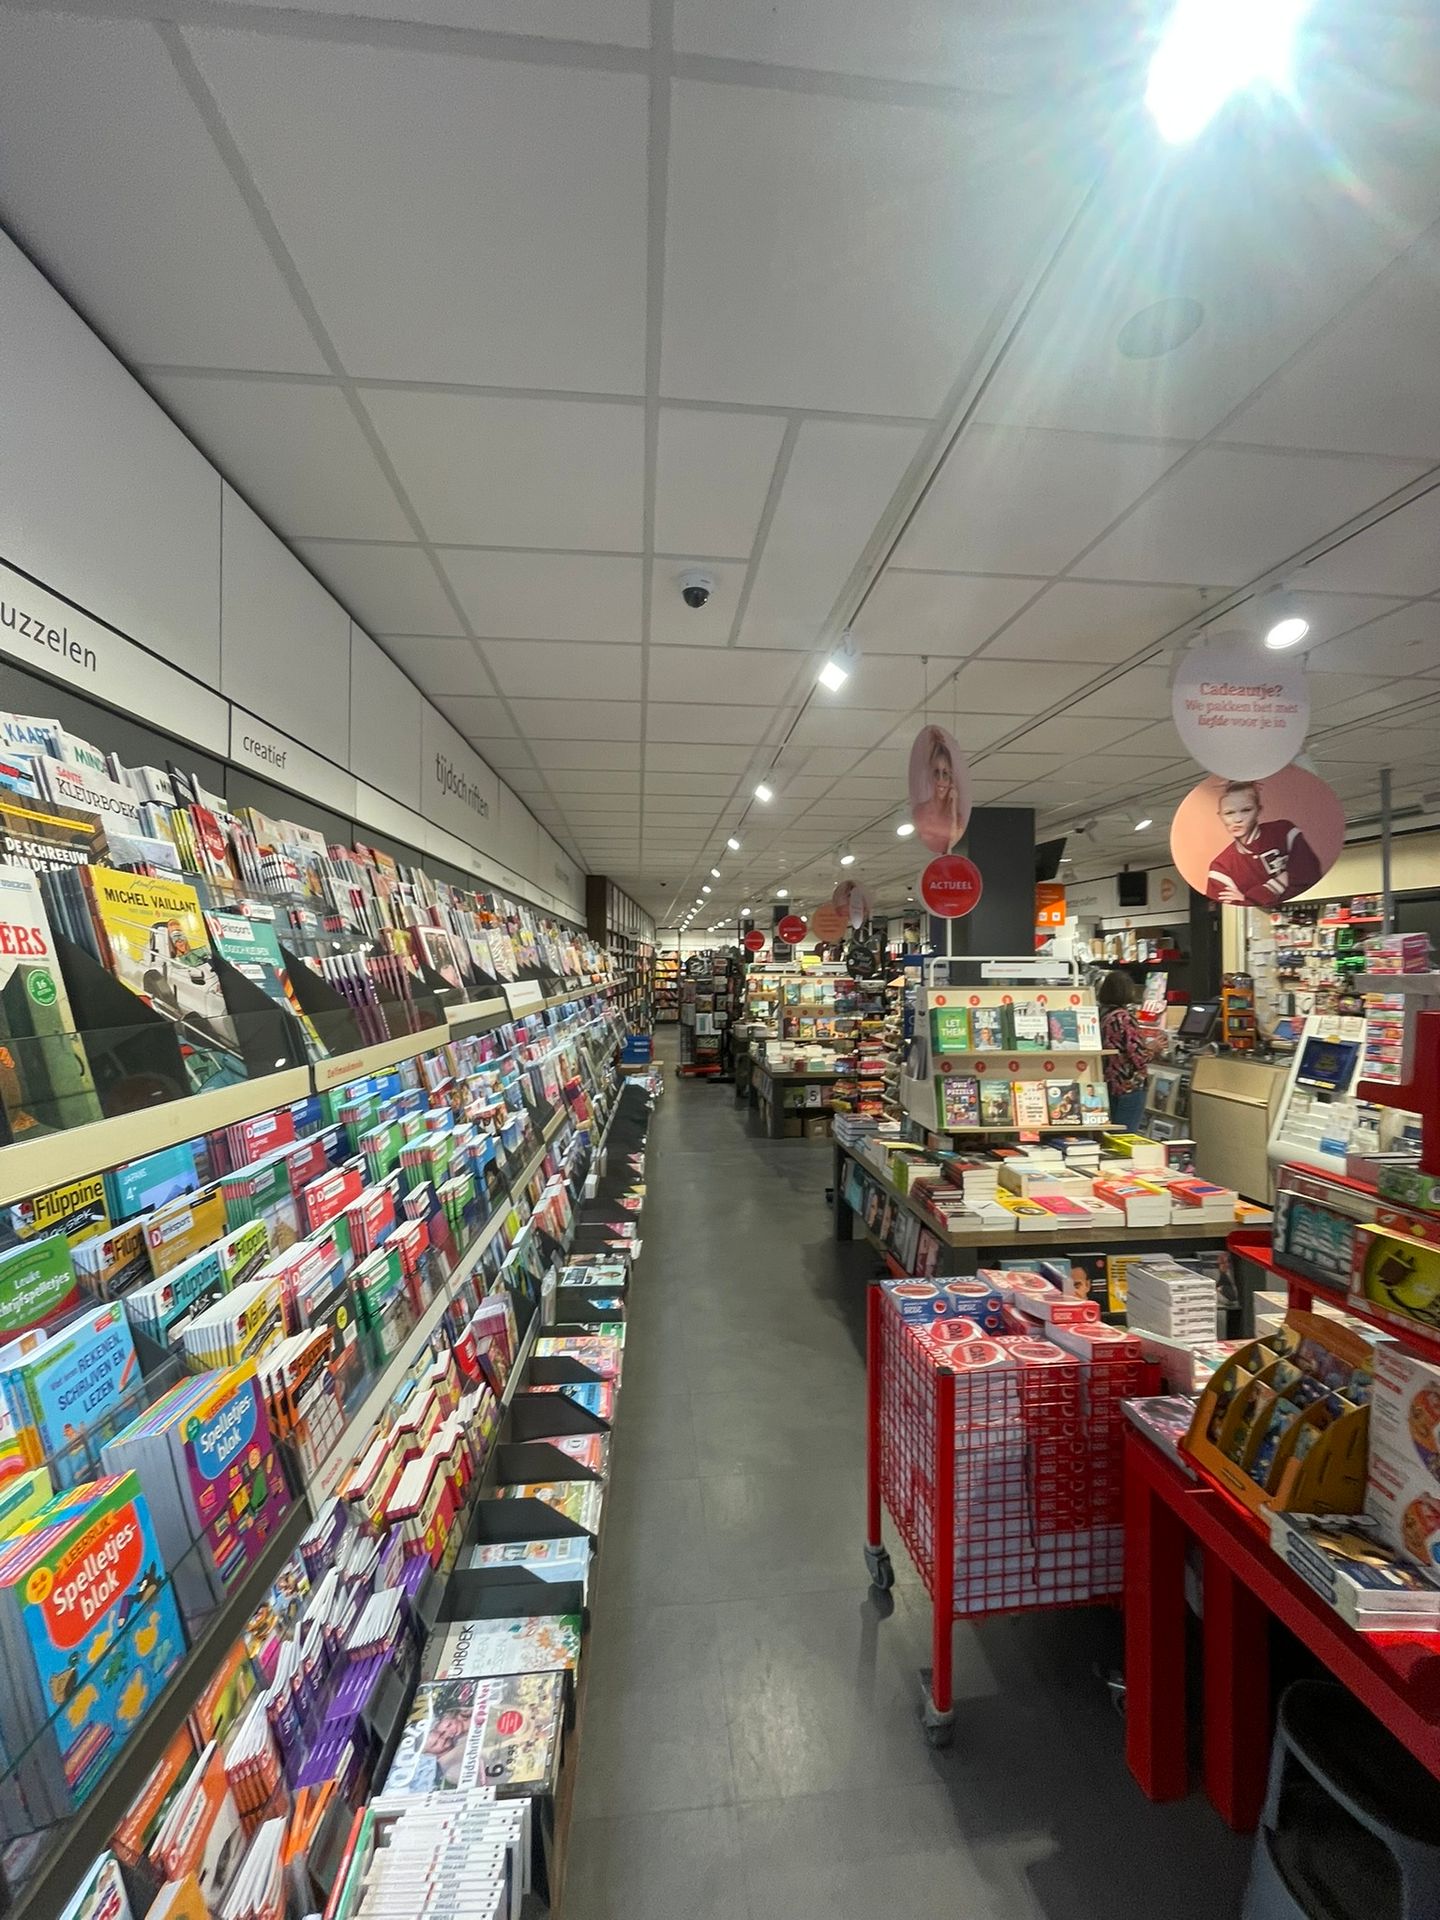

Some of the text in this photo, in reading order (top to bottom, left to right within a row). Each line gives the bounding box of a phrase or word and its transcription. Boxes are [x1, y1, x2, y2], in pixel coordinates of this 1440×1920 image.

[1200, 682, 1283, 699] Cadeautje?
[1206, 700, 1251, 714] pakken
[243, 736, 288, 770] creatief
[435, 752, 490, 820] tijdschriften
[5, 837, 89, 866] DE SCHREEUW
[31, 857, 49, 873] DE
[929, 880, 973, 891] ACTUEEL
[104, 887, 149, 907] MICHEL
[150, 895, 197, 914] VAILLANT
[941, 1028, 966, 1036] THEM
[945, 1019, 961, 1028] LET
[34, 1181, 104, 1221] Filippine
[58, 1359, 114, 1412] SCHRIJVEN
[112, 1347, 126, 1368] EN
[83, 1380, 115, 1414] LEZEN
[217, 1432, 242, 1462] blok
[52, 1523, 138, 1617] Spelletjes-
[78, 1569, 120, 1621] blok
